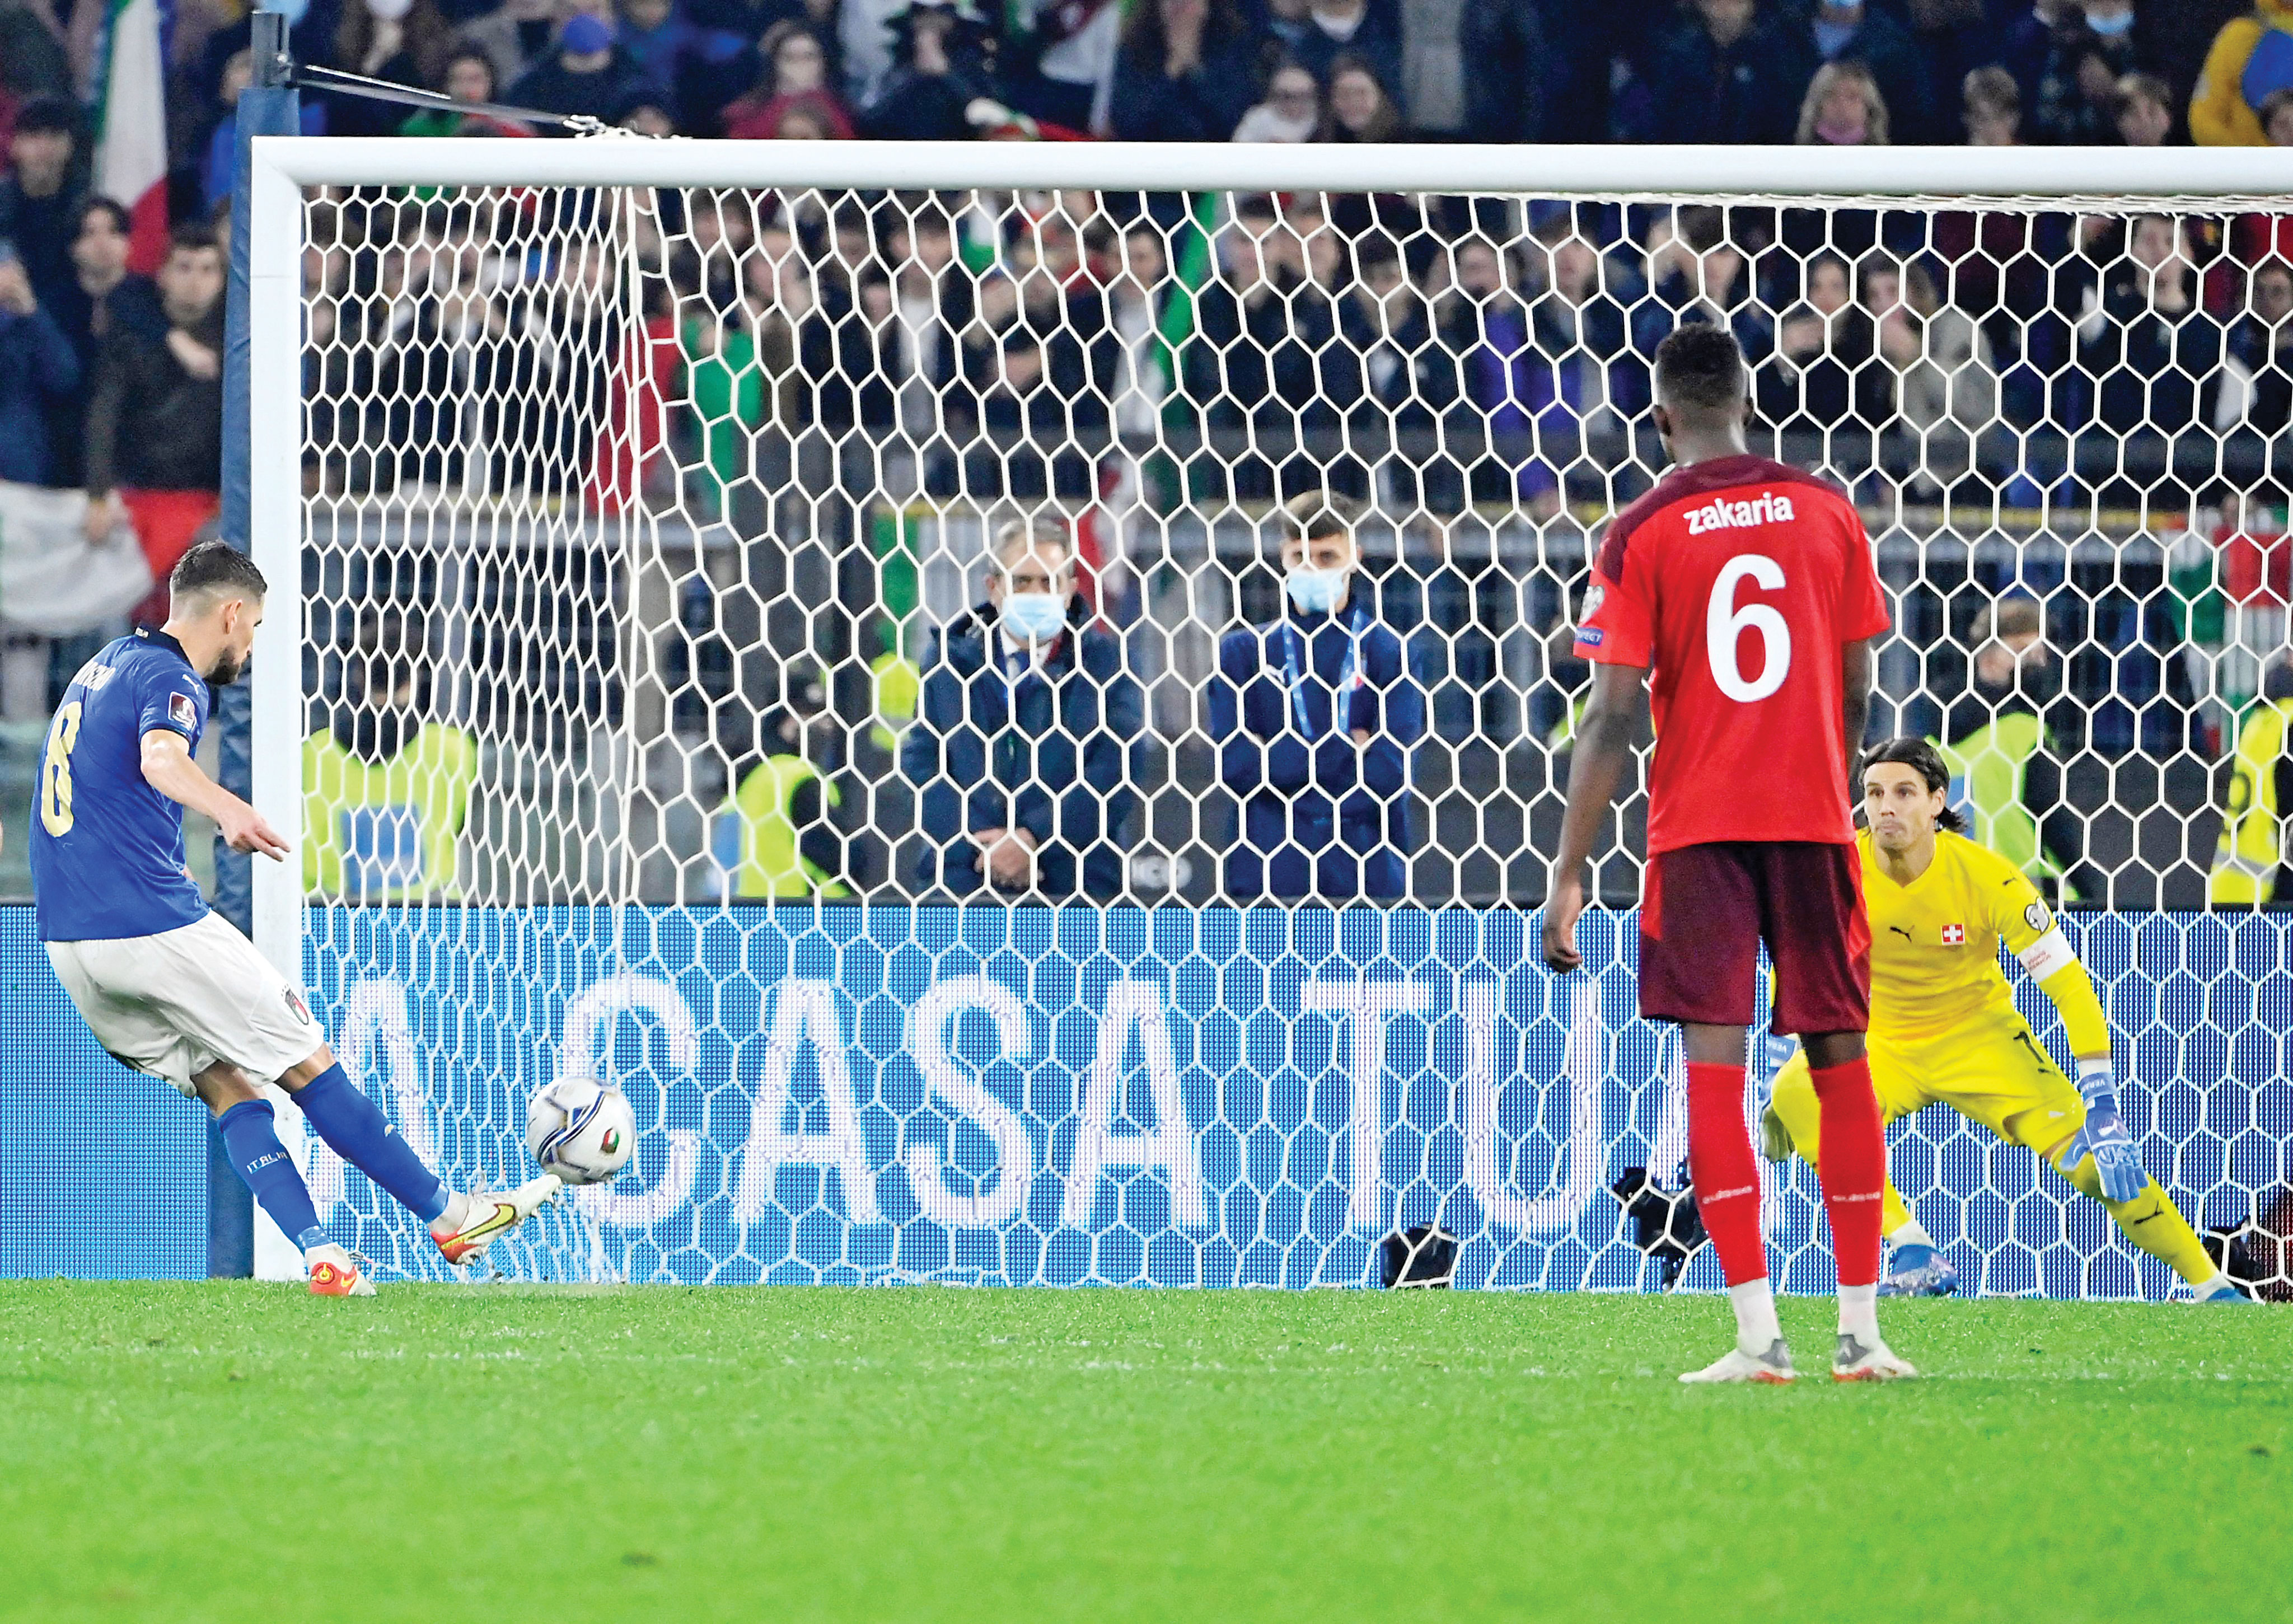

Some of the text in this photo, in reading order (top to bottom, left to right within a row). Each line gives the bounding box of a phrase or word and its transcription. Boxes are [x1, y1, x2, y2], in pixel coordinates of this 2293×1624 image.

[1683, 491, 1795, 535] zakaria
[1706, 554, 1791, 703] 6
[563, 974, 1208, 1230] CASA
